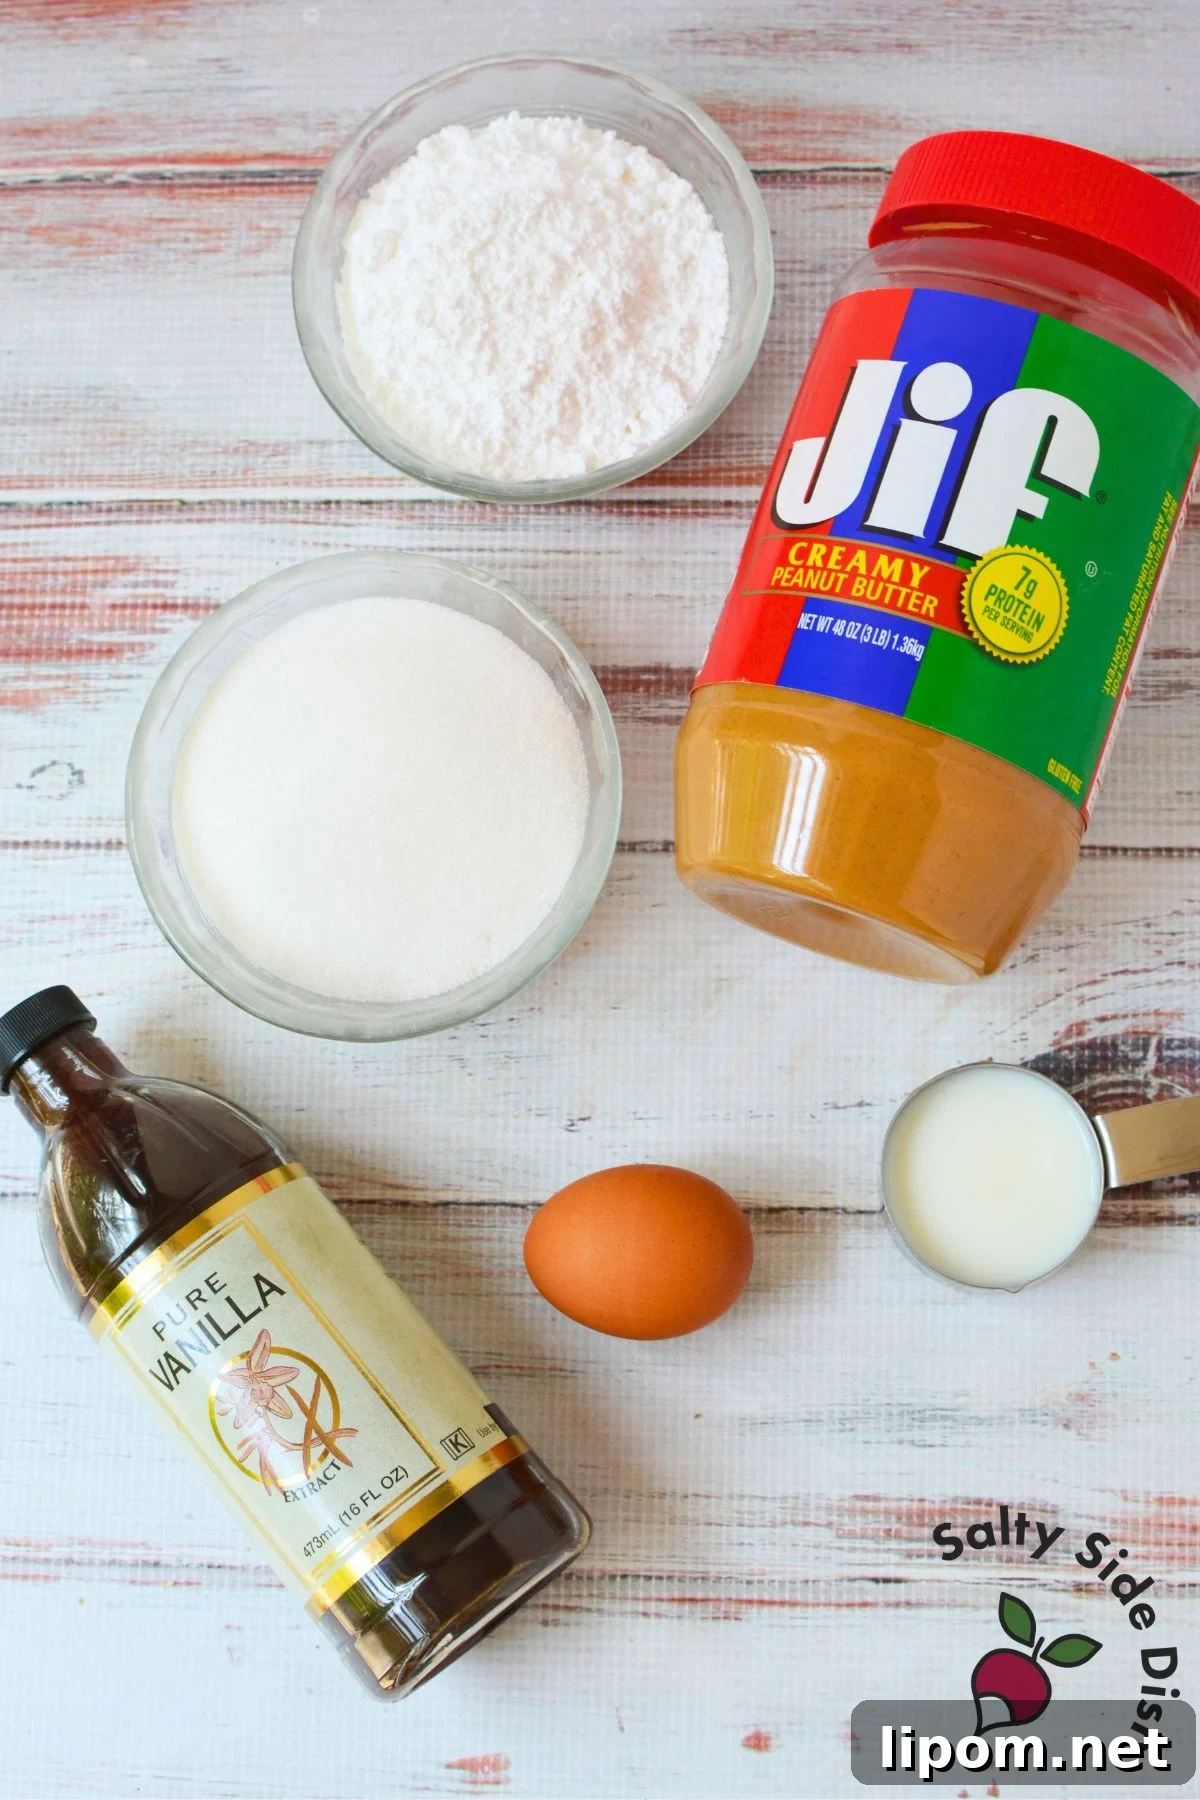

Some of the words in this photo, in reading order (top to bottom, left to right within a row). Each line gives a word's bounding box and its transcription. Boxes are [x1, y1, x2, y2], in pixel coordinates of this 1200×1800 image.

[772, 359, 1100, 560] Jif
[1152, 512, 1165, 541] AND
[1161, 491, 1172, 515] FAT
[1167, 499, 1178, 523] SEE
[788, 541, 930, 588] CREAMY
[1129, 541, 1156, 611] SATURATED
[1146, 524, 1169, 588] NUTRITION
[771, 566, 848, 593] PEANUT
[851, 576, 939, 617] BUTTER
[1014, 565, 1038, 600] 7g
[982, 604, 1000, 623] PER
[1000, 615, 1034, 644] SERVING
[984, 583, 1045, 632] PROTEIN
[1120, 589, 1150, 671] INFORMATION
[1123, 612, 1134, 637] FAT
[797, 612, 818, 631] NET
[816, 615, 833, 633] WT
[832, 619, 847, 637] 48
[845, 621, 862, 639] OZ
[860, 623, 873, 643] (3
[872, 628, 891, 650] LB)
[891, 633, 925, 661] 1.36kg
[1110, 671, 1122, 697] FOR
[1047, 758, 1071, 784] GLUTEN
[1069, 773, 1083, 795] FREE
[152, 1271, 227, 1342] PURE
[149, 1273, 287, 1392] VANILLA
[476, 1426, 492, 1438] Use
[283, 1459, 341, 1503] EXTRACT
[303, 1523, 340, 1558] 473mL
[338, 1503, 361, 1527] (16
[359, 1489, 382, 1507] FL
[380, 1465, 409, 1490] OZ)
